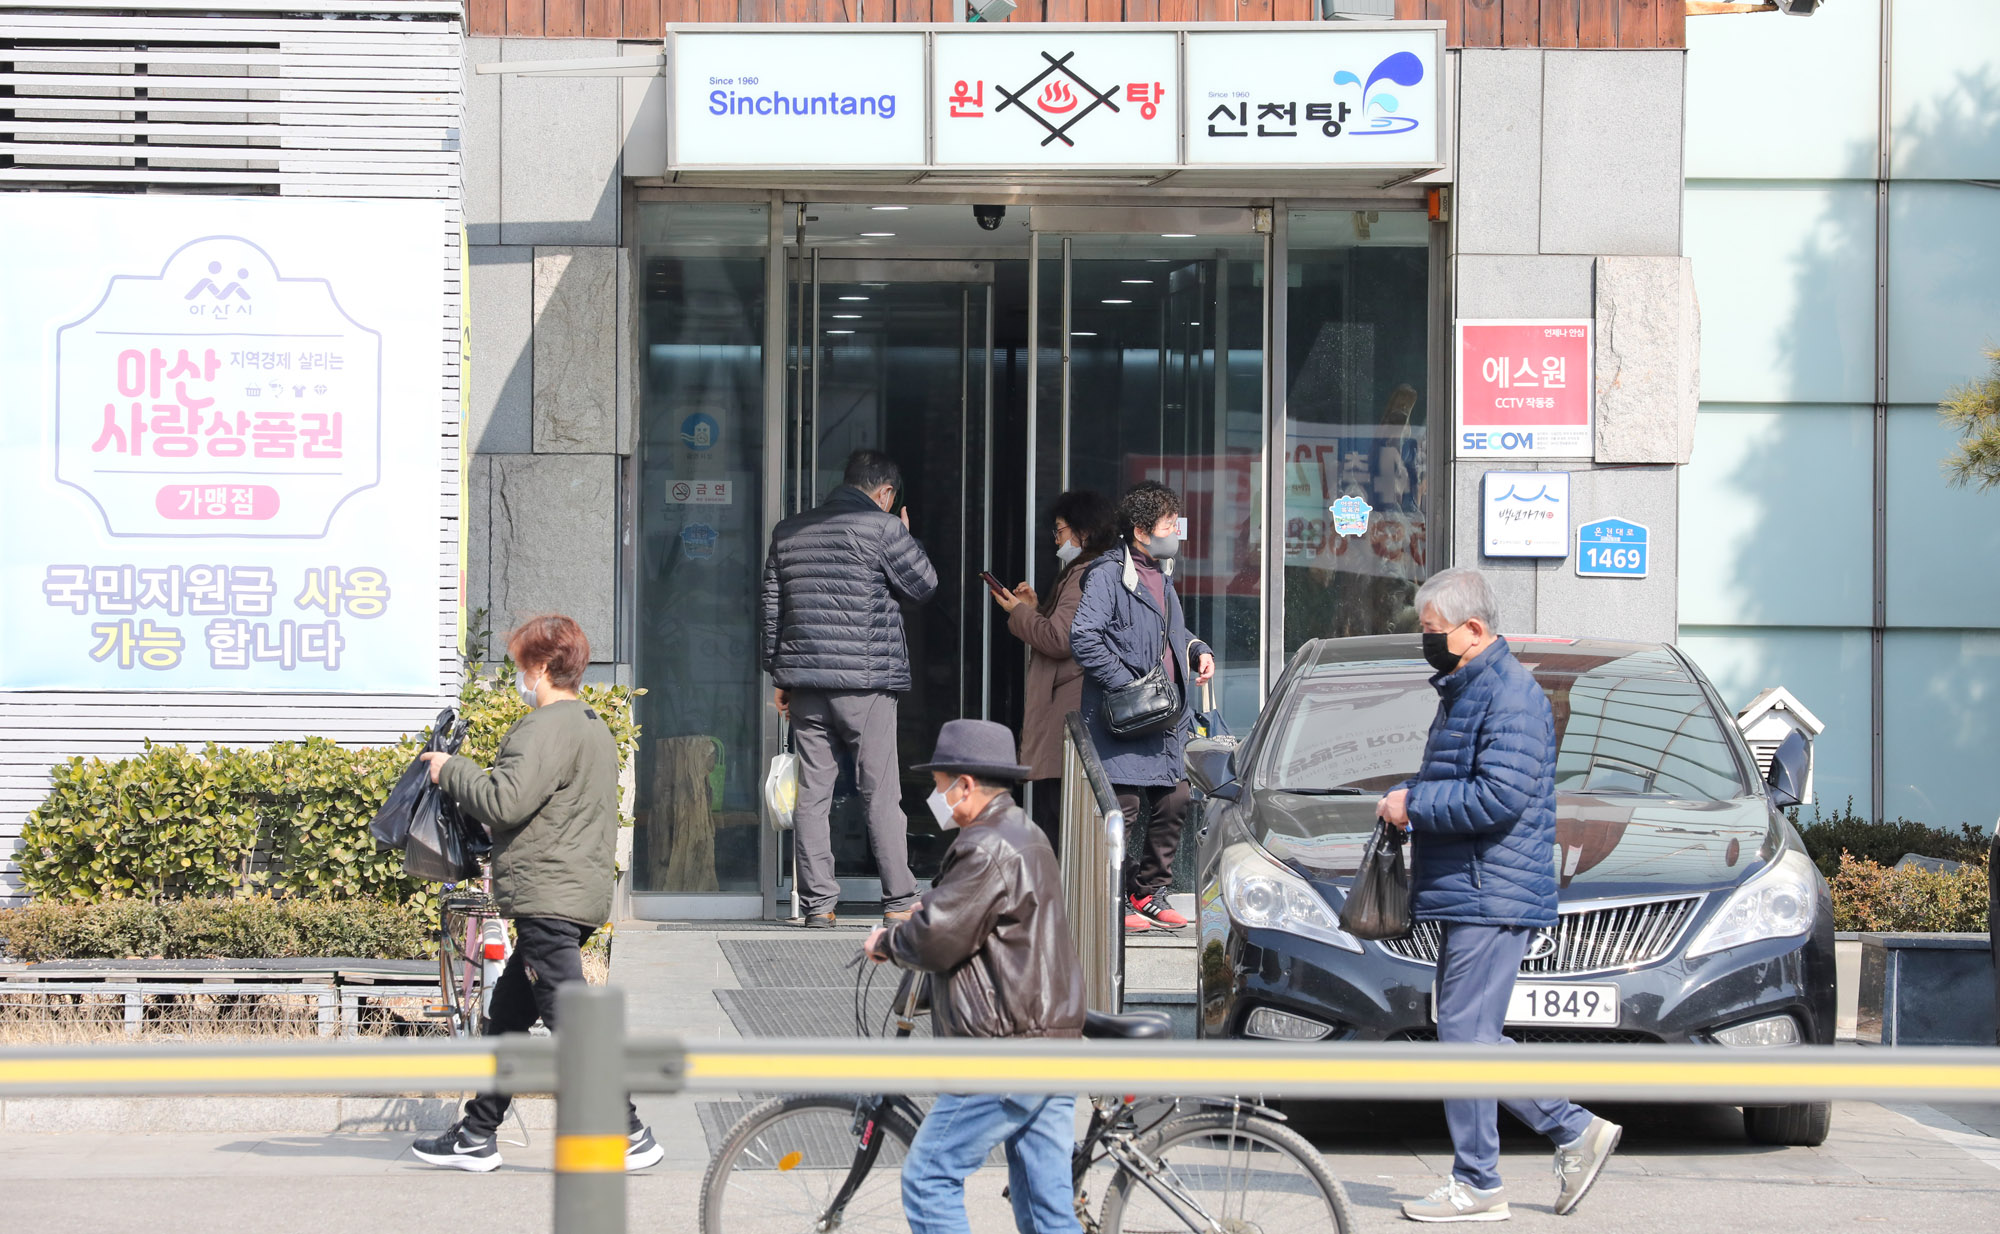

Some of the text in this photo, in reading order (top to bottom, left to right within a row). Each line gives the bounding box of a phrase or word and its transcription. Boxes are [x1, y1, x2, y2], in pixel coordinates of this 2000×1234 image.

[709, 77, 759, 85] Since 1960
[709, 90, 896, 119] Sinchuntang
[949, 80, 1165, 120] 원 탕
[1207, 101, 1351, 138] 신천탕
[189, 304, 252, 319] 아산시
[1544, 328, 1585, 338] 언제나 안심
[230, 351, 344, 370] 지역경제 살리는
[1482, 356, 1566, 389] 에스원
[117, 348, 221, 409] 아산
[1495, 397, 1555, 409] CCTV 작동중
[91, 402, 343, 459] 사랑상품권
[1463, 432, 1533, 450] SECOM
[178, 487, 254, 515] 가맹점
[1587, 547, 1640, 569] 1469
[43, 565, 391, 619] 국민지원금 사용
[89, 619, 346, 672] 가능 합니다
[1526, 990, 1600, 1017] 1849
